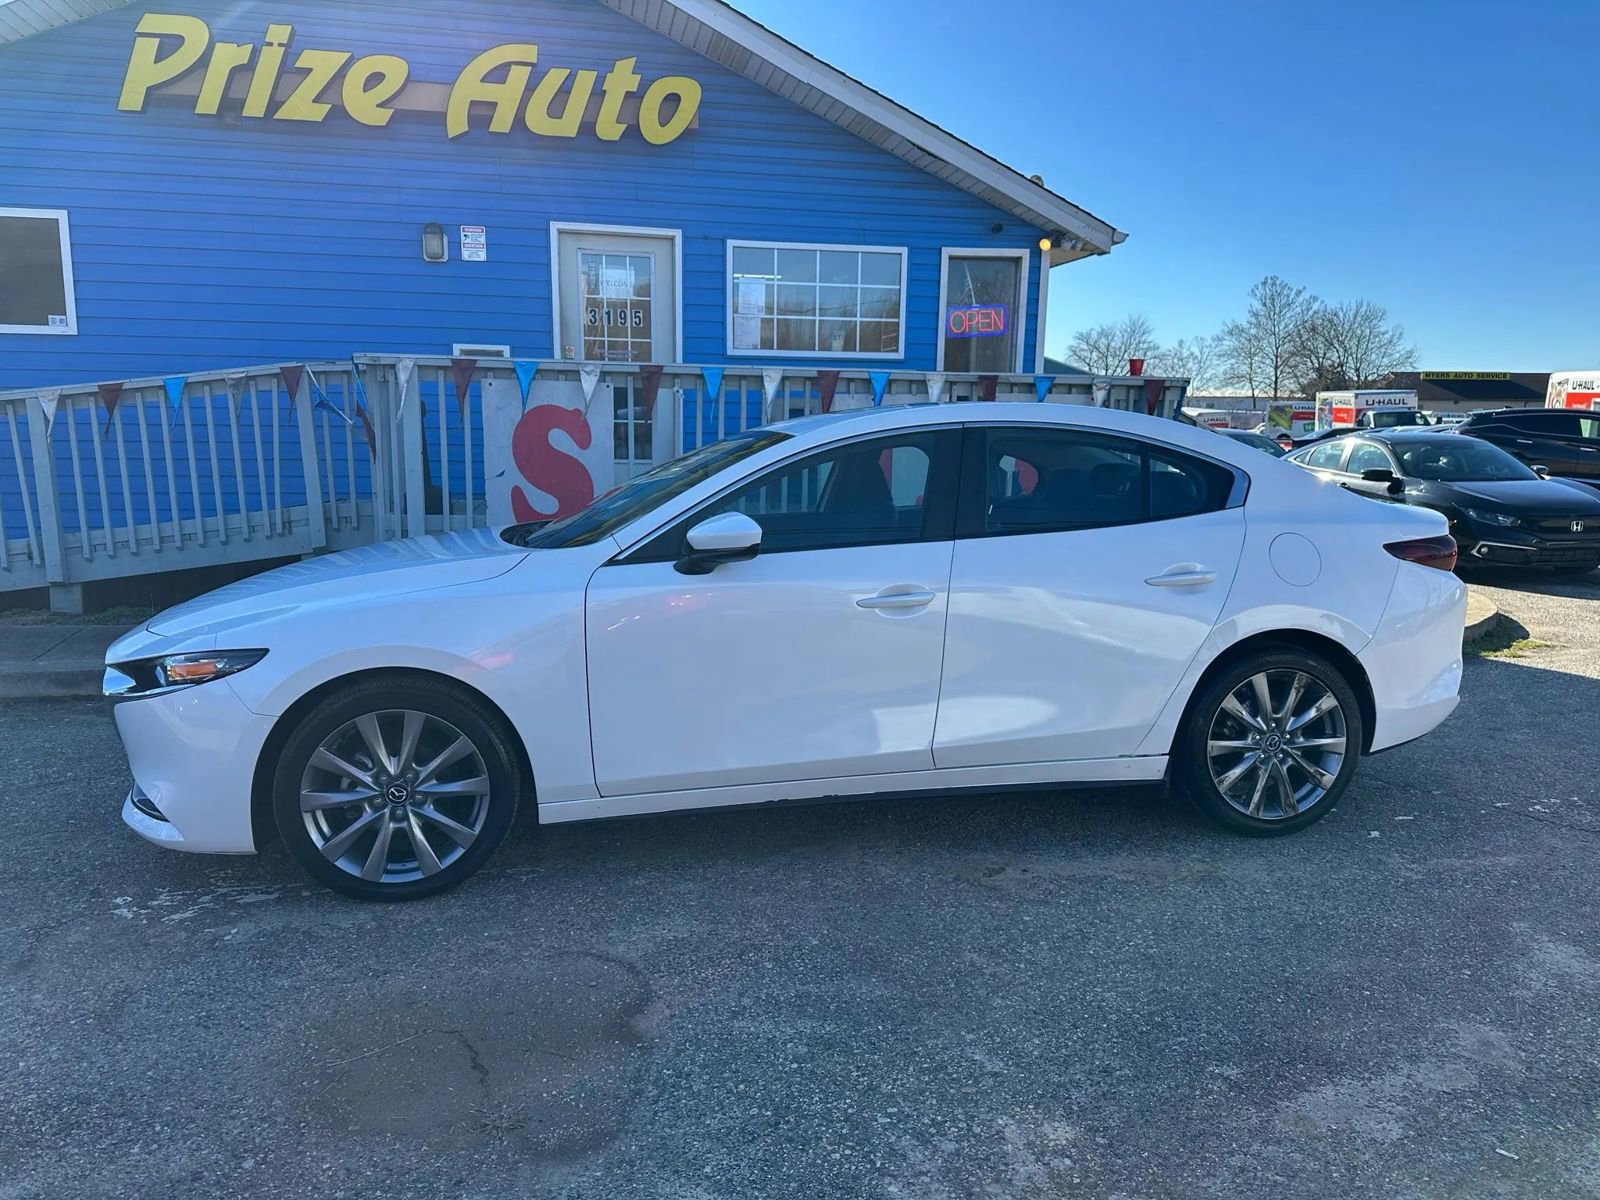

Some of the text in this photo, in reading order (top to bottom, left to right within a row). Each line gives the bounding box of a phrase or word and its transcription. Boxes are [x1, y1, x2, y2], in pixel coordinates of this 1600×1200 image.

[117, 13, 702, 145] Prize Auto
[589, 308, 642, 326] 3195
[950, 309, 1004, 333] OPEN
[1365, 398, 1408, 406] U-HAUL
